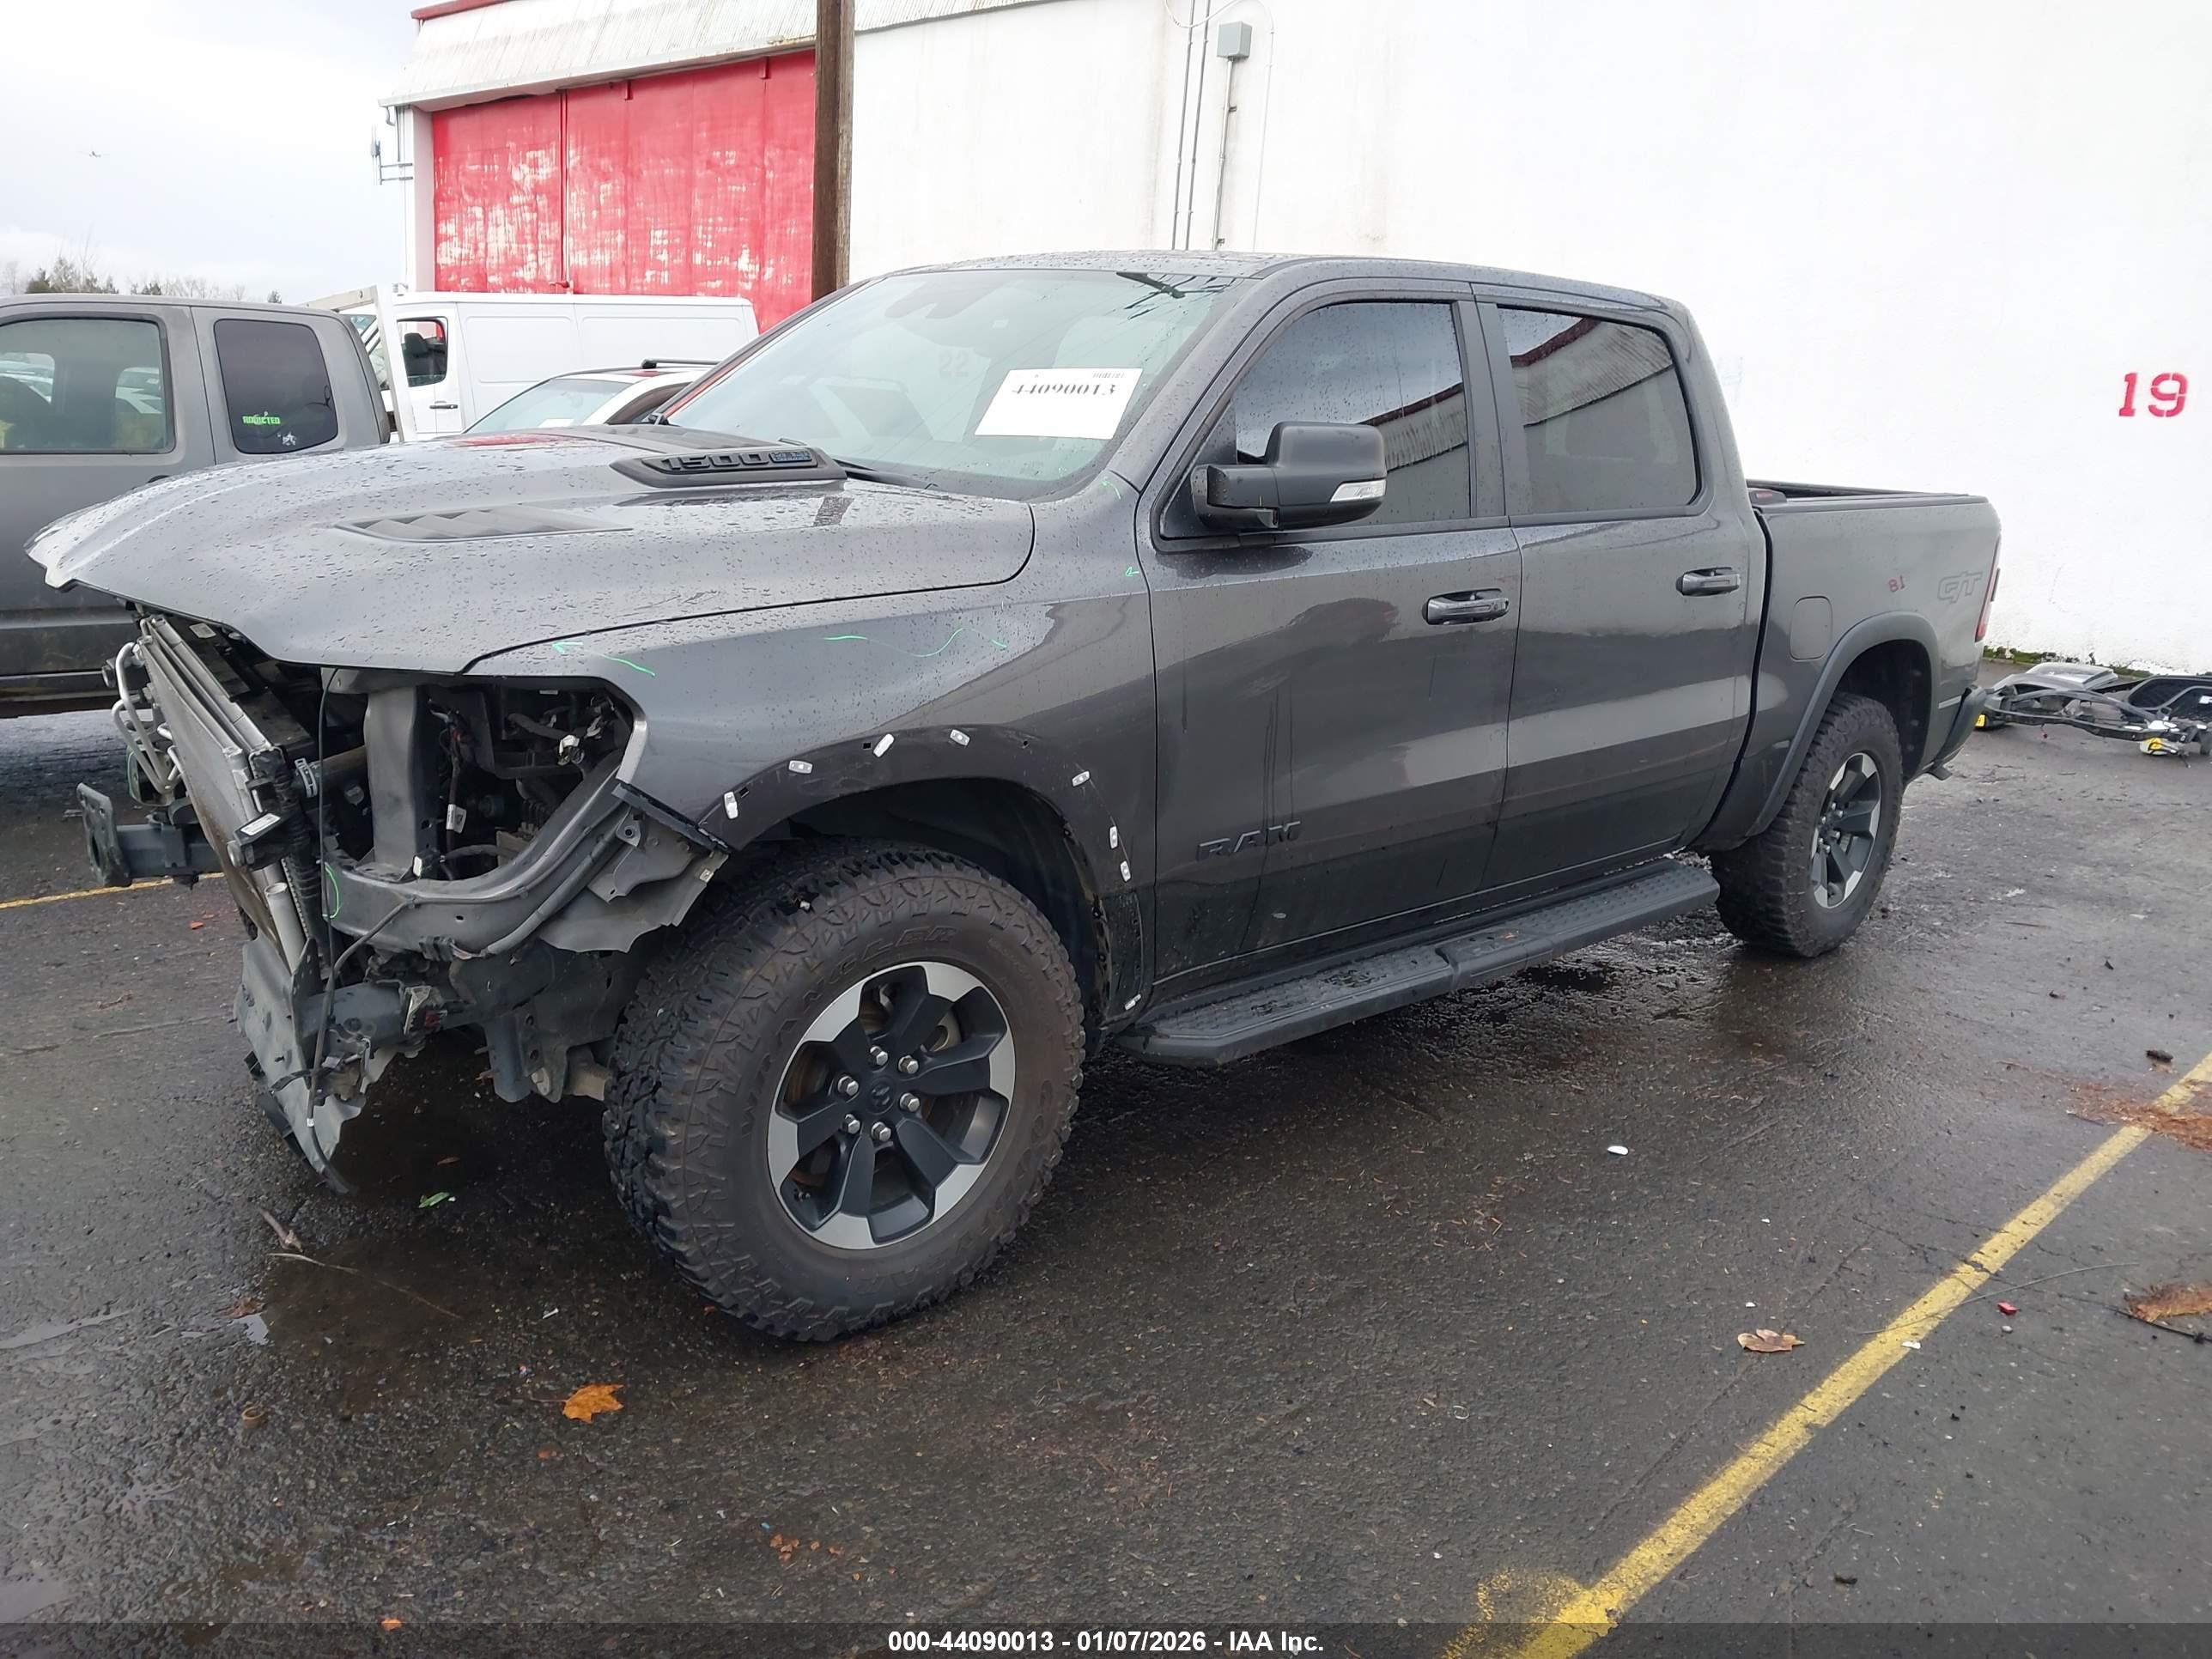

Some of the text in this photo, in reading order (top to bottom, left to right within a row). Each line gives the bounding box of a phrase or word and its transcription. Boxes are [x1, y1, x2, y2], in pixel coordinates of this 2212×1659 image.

[2118, 372, 2189, 417] 19
[661, 451, 769, 471] 1500
[1936, 570, 1984, 605] GT
[1195, 820, 1302, 862] RAM
